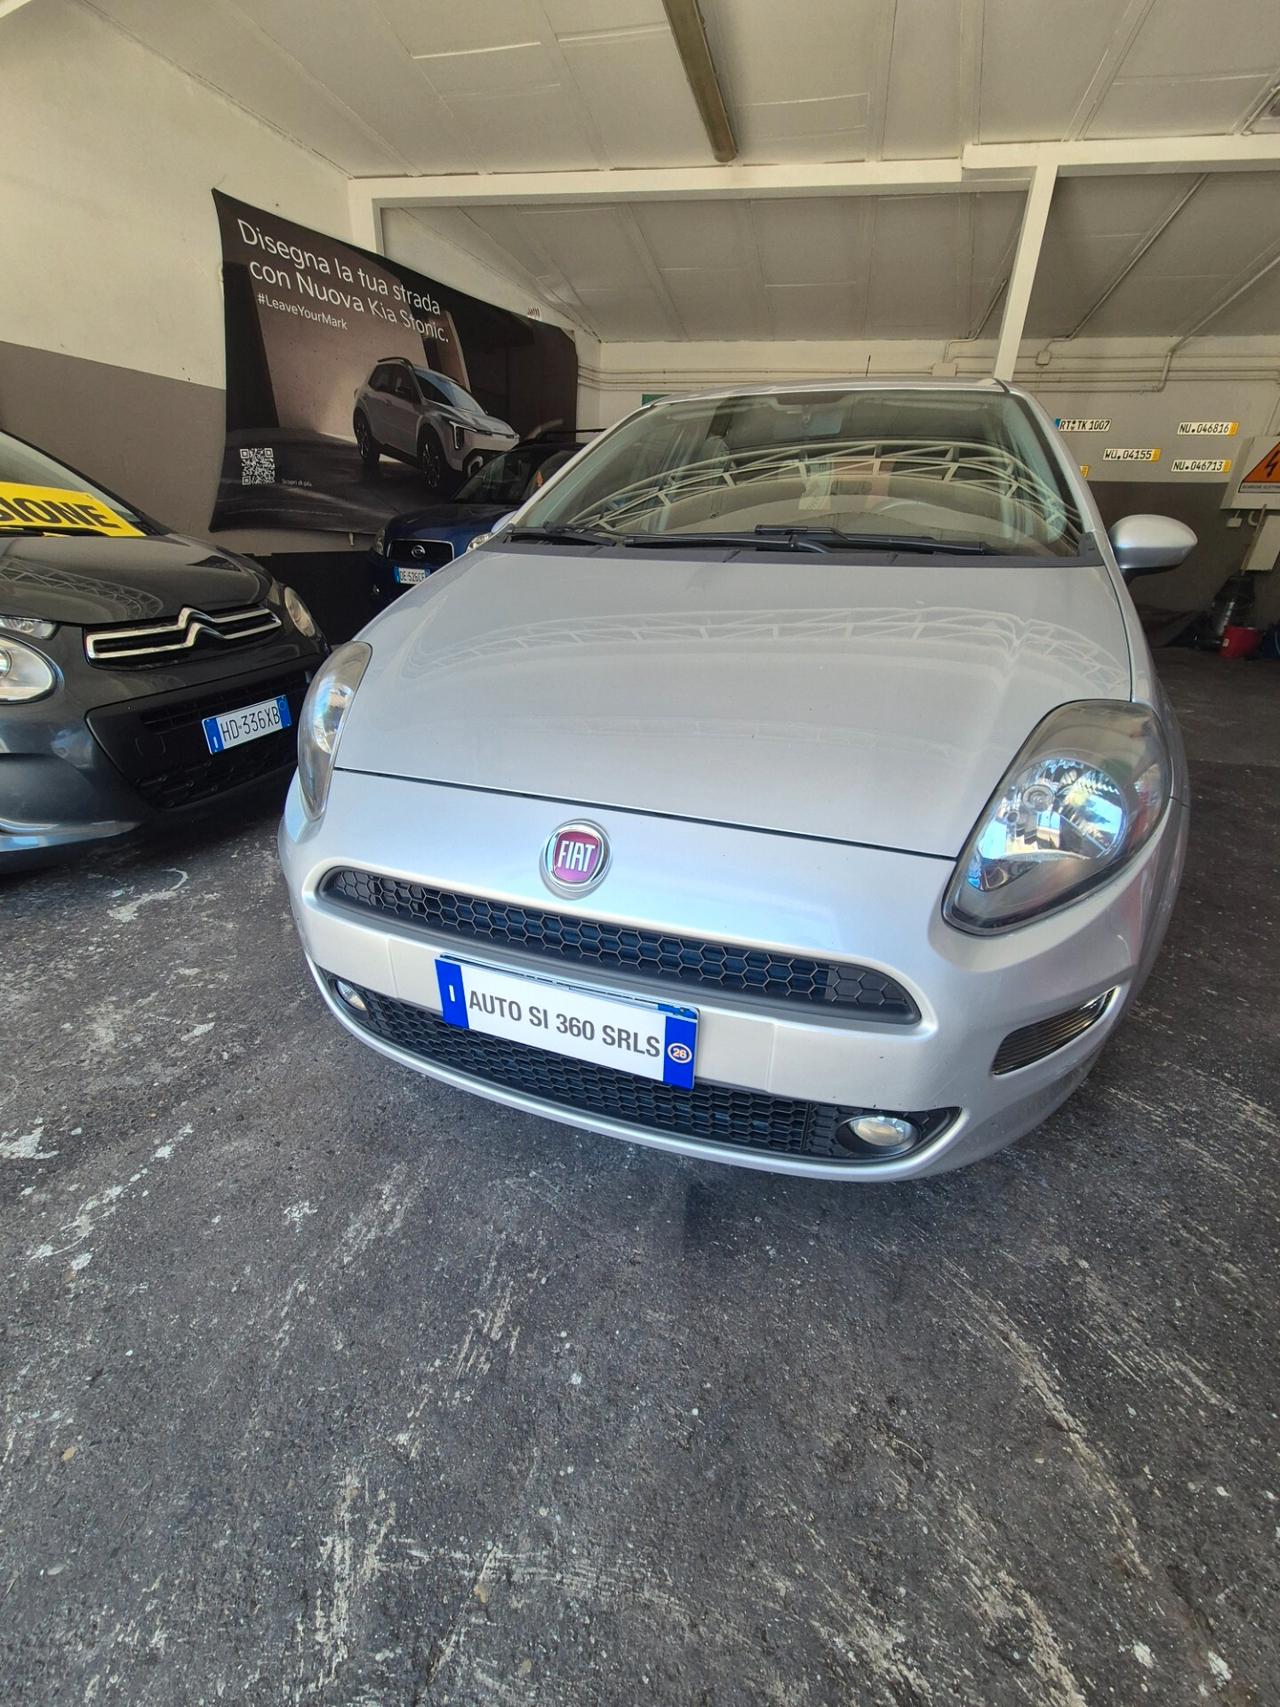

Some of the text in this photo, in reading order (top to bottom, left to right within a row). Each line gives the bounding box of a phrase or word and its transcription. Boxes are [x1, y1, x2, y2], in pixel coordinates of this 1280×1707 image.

[237, 218, 441, 316] Disegna la tua strada
[250, 261, 449, 343] con Nuova Kia Stonic.
[257, 293, 348, 330] #LeaveYourMark
[557, 840, 596, 872] FIAT
[468, 990, 522, 1022] AUTO
[529, 1005, 549, 1029] SI
[556, 1013, 595, 1041] 360
[602, 1025, 661, 1058] SRLS
[672, 1047, 687, 1059] 26
